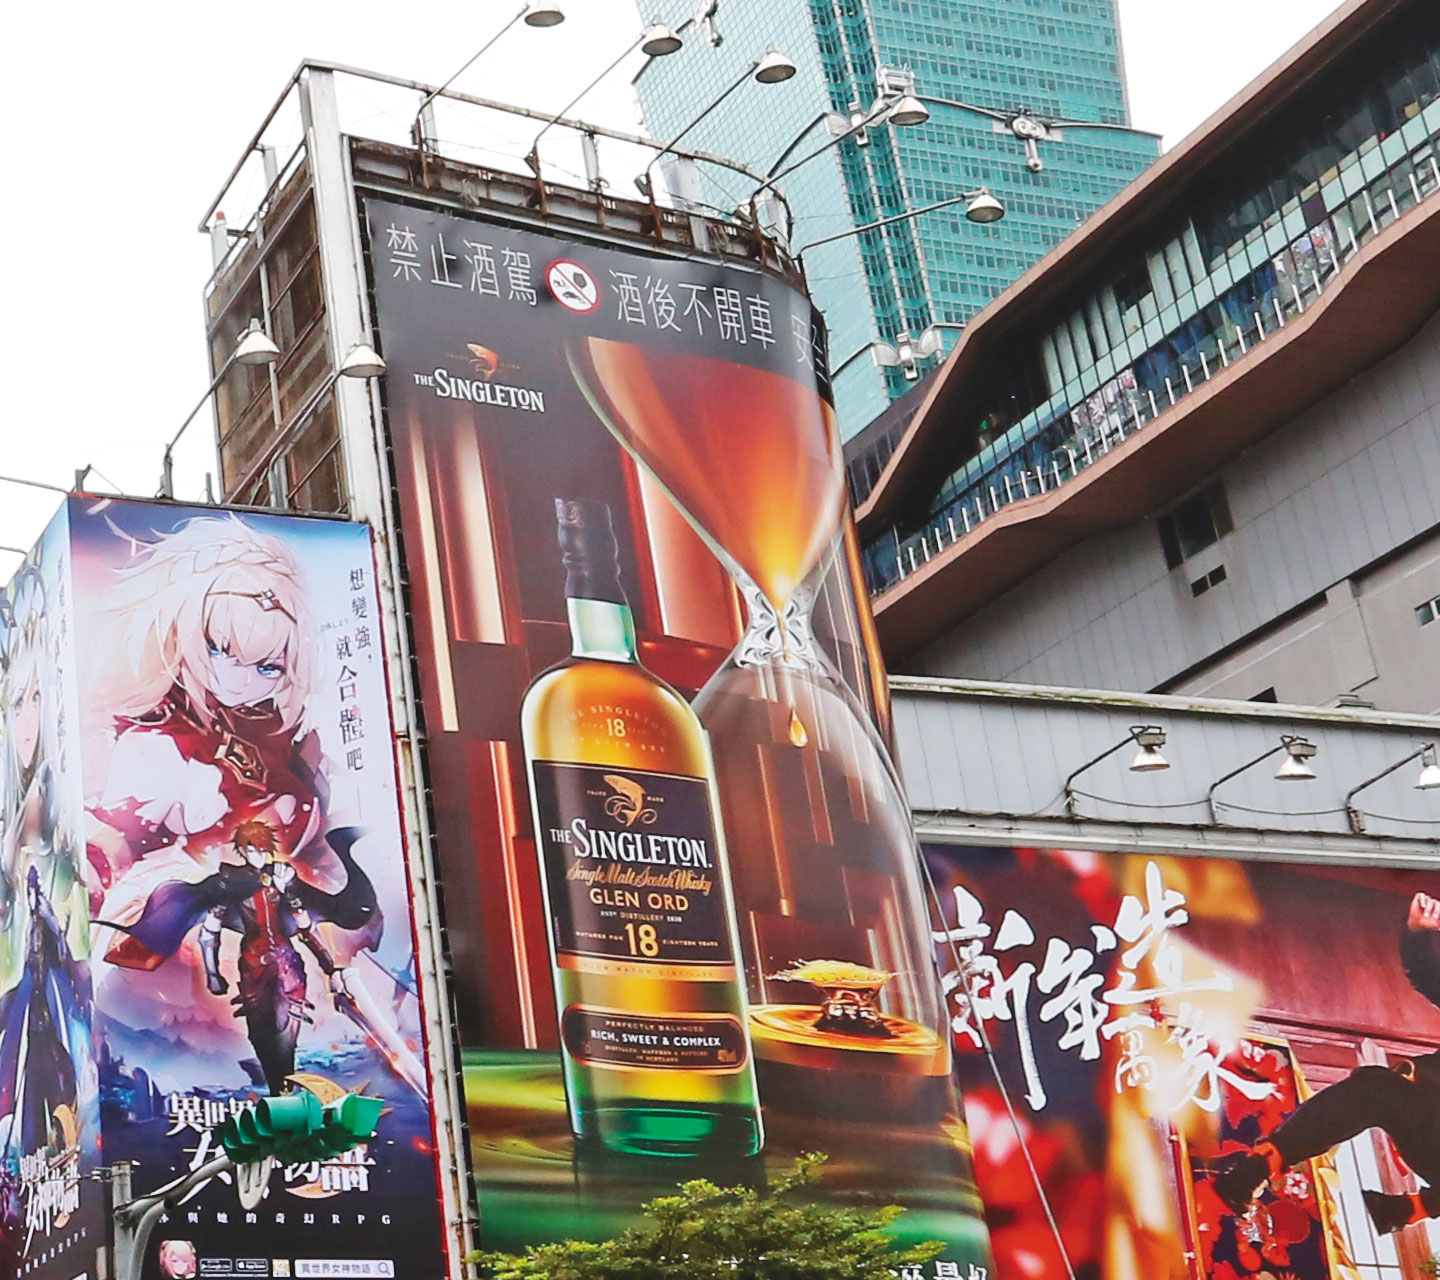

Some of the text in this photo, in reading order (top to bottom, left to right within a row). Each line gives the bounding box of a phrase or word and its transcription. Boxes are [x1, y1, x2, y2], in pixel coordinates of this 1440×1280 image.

[385, 223, 776, 351] 禁止酒駕 酒後不開車
[413, 368, 545, 413] THE SINGLETON
[336, 638, 365, 772] 就合體吧
[606, 718, 626, 737] 18
[550, 828, 572, 844] THE
[565, 859, 713, 897] Single Malt Scotch Whisky
[589, 887, 689, 911] GLEN ORD
[624, 922, 660, 958] 18
[621, 1032, 658, 1045] SWEET
[662, 1036, 670, 1046] &
[672, 1036, 722, 1047] COMPLEX
[301, 1261, 371, 1275] 異世界女神物語
